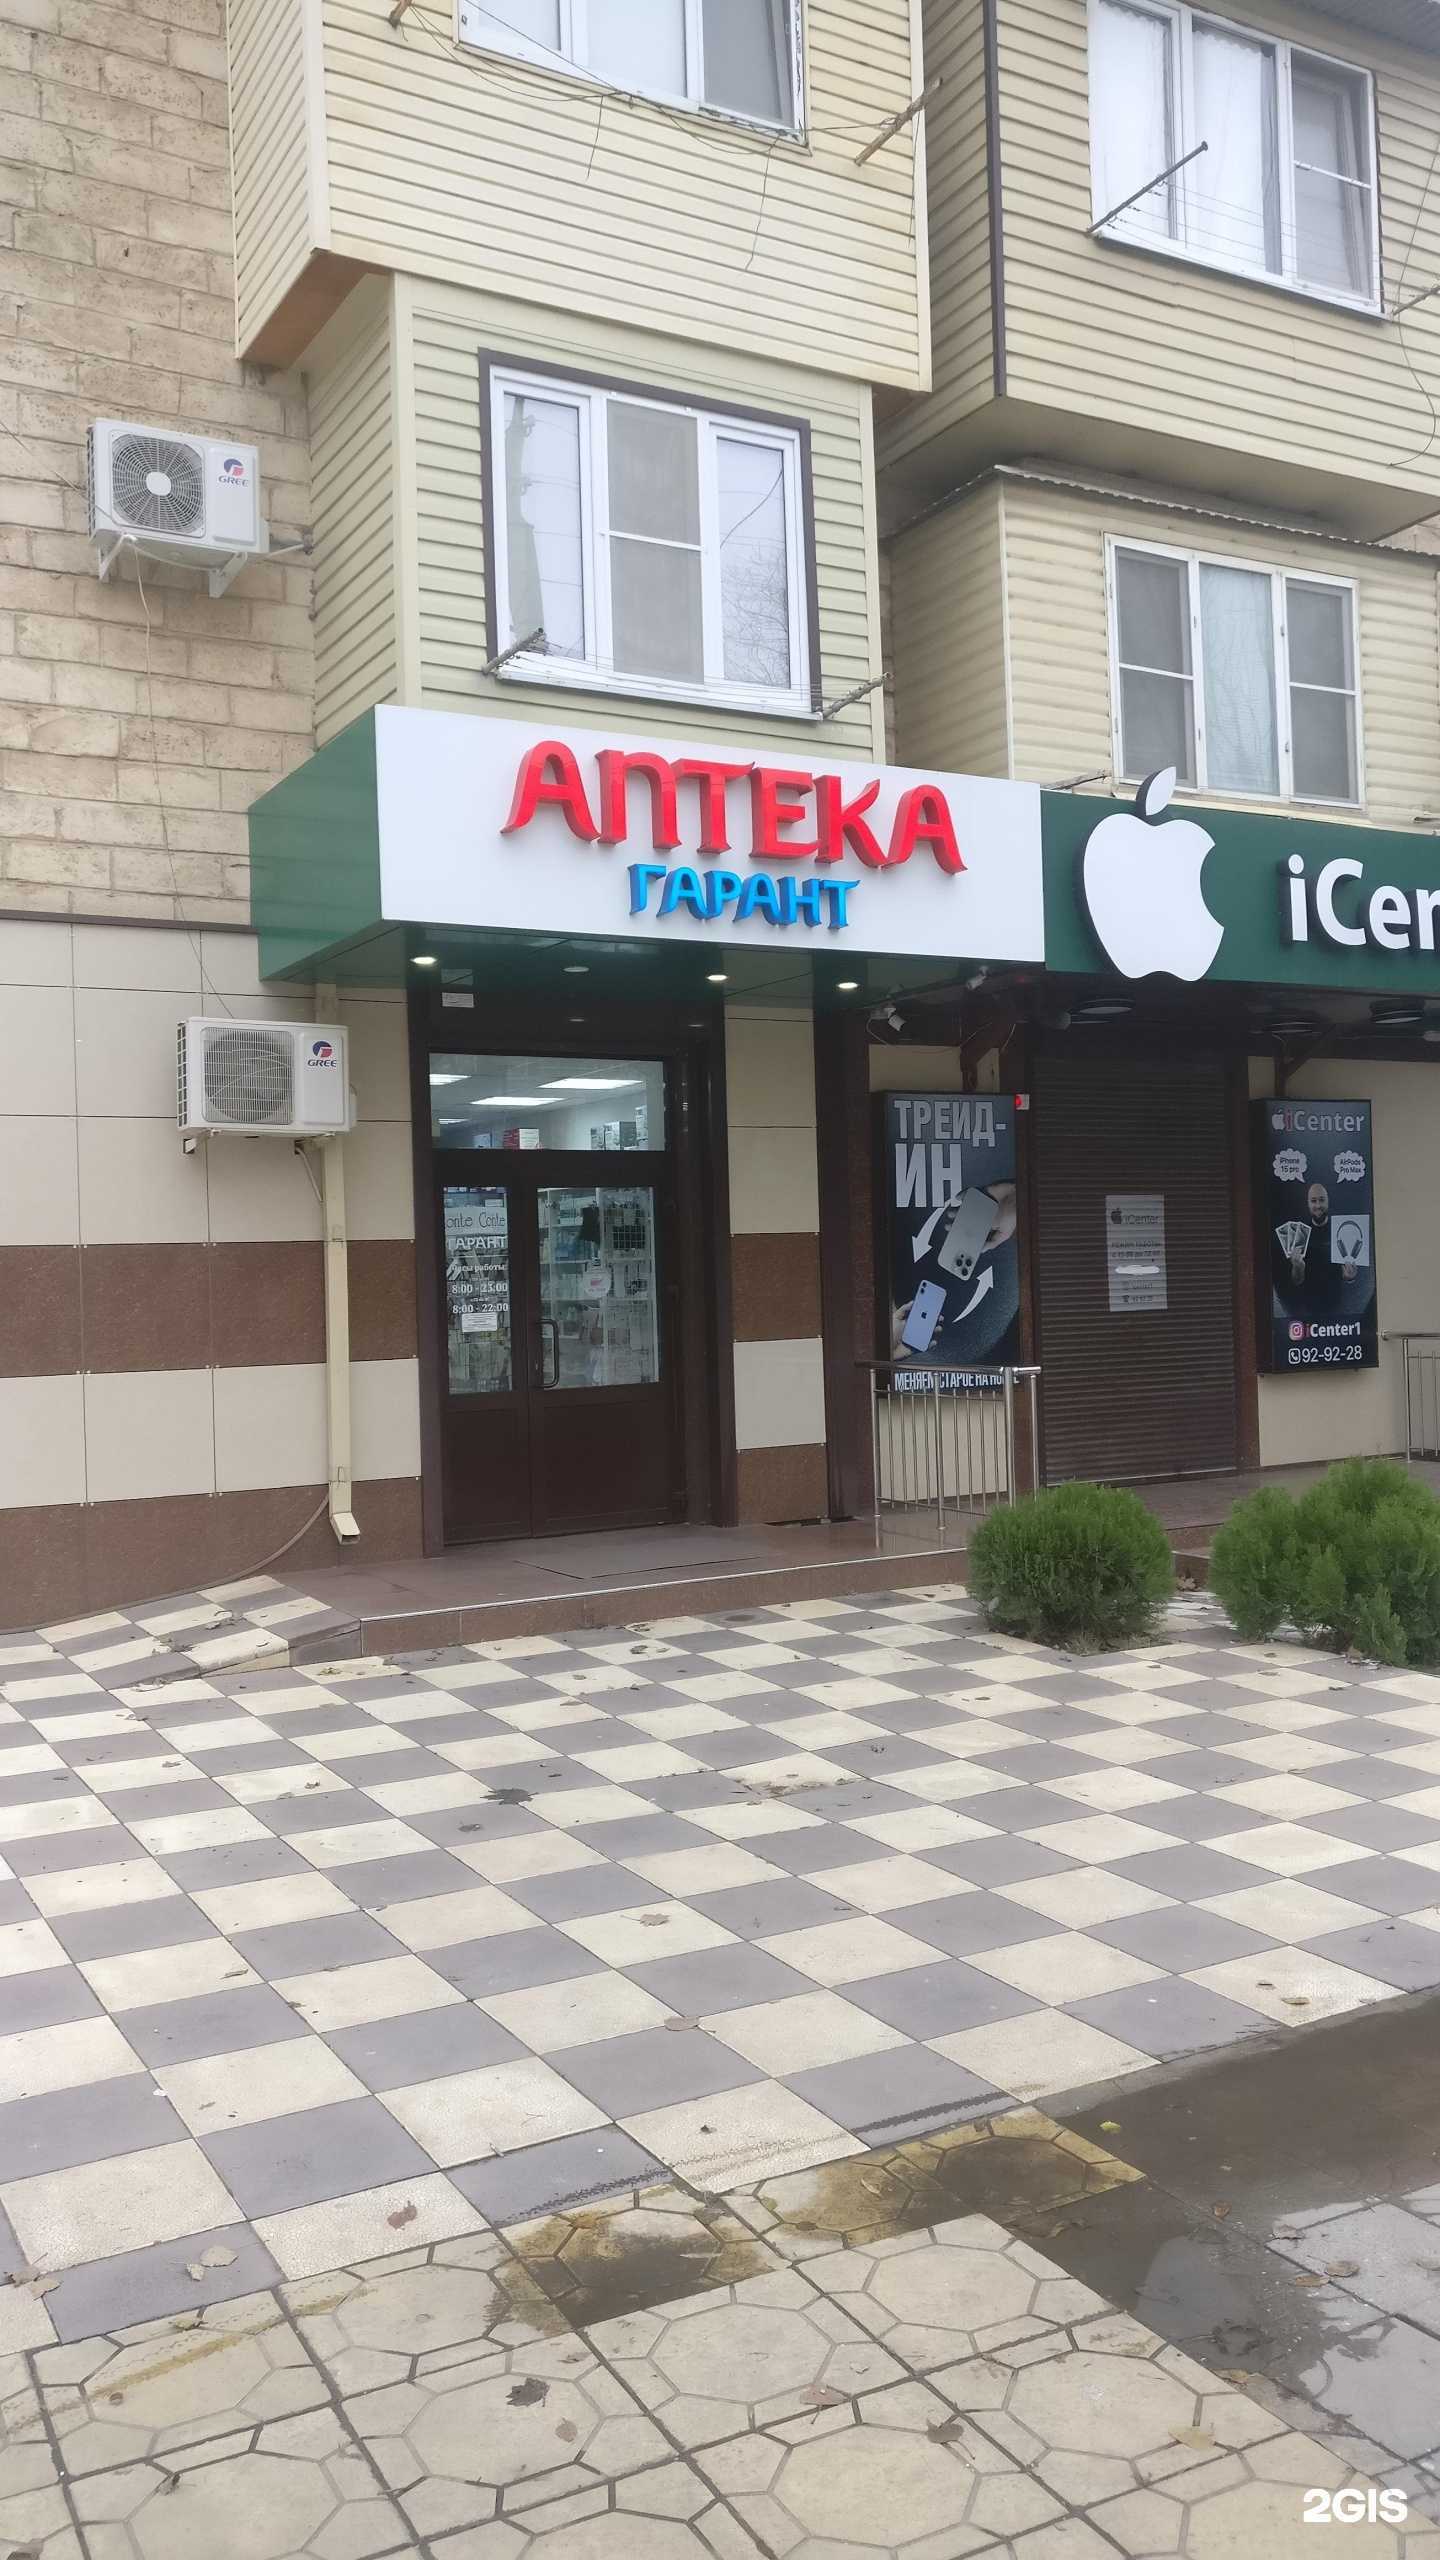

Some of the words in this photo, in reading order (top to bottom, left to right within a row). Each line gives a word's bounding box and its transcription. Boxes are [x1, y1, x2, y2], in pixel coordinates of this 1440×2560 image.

[218, 475, 249, 487] GREE
[500, 740, 968, 875] АПТЕКА
[627, 863, 860, 930] ГАРАНТ
[307, 1059, 337, 1068] GREE
[1285, 1109, 1365, 1132] iCenter
[895, 1143, 962, 1208] ИН
[451, 1283, 473, 1294] 8:00
[452, 1304, 474, 1314] 8:00
[481, 1303, 509, 1312] 22:00
[1306, 1321, 1361, 1338] iCenter1
[1301, 1345, 1362, 1363] 92-92-28
